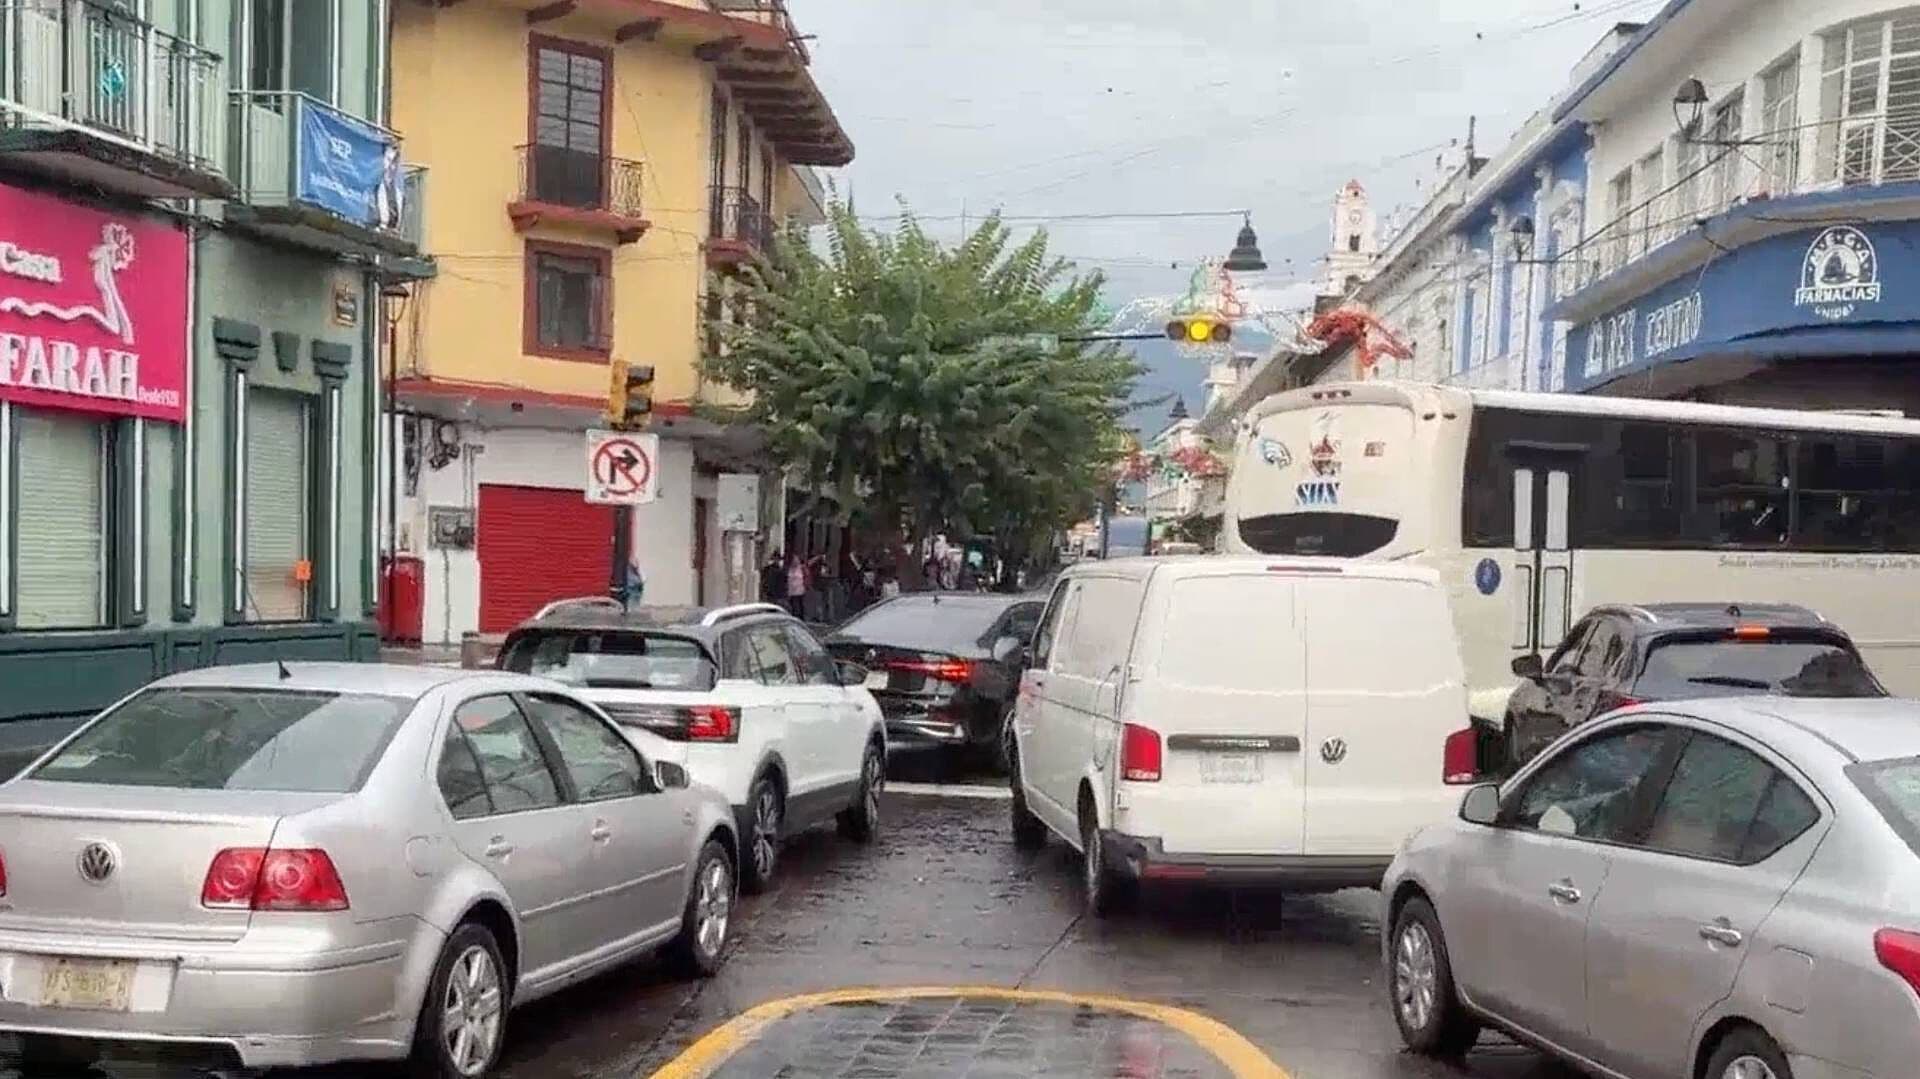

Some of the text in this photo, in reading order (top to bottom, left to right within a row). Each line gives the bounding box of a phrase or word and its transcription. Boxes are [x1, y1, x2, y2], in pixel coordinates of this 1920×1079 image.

[0, 241, 63, 284] Casa
[1800, 286, 1877, 304] FARMACIAS
[0, 332, 140, 401] FARAH
